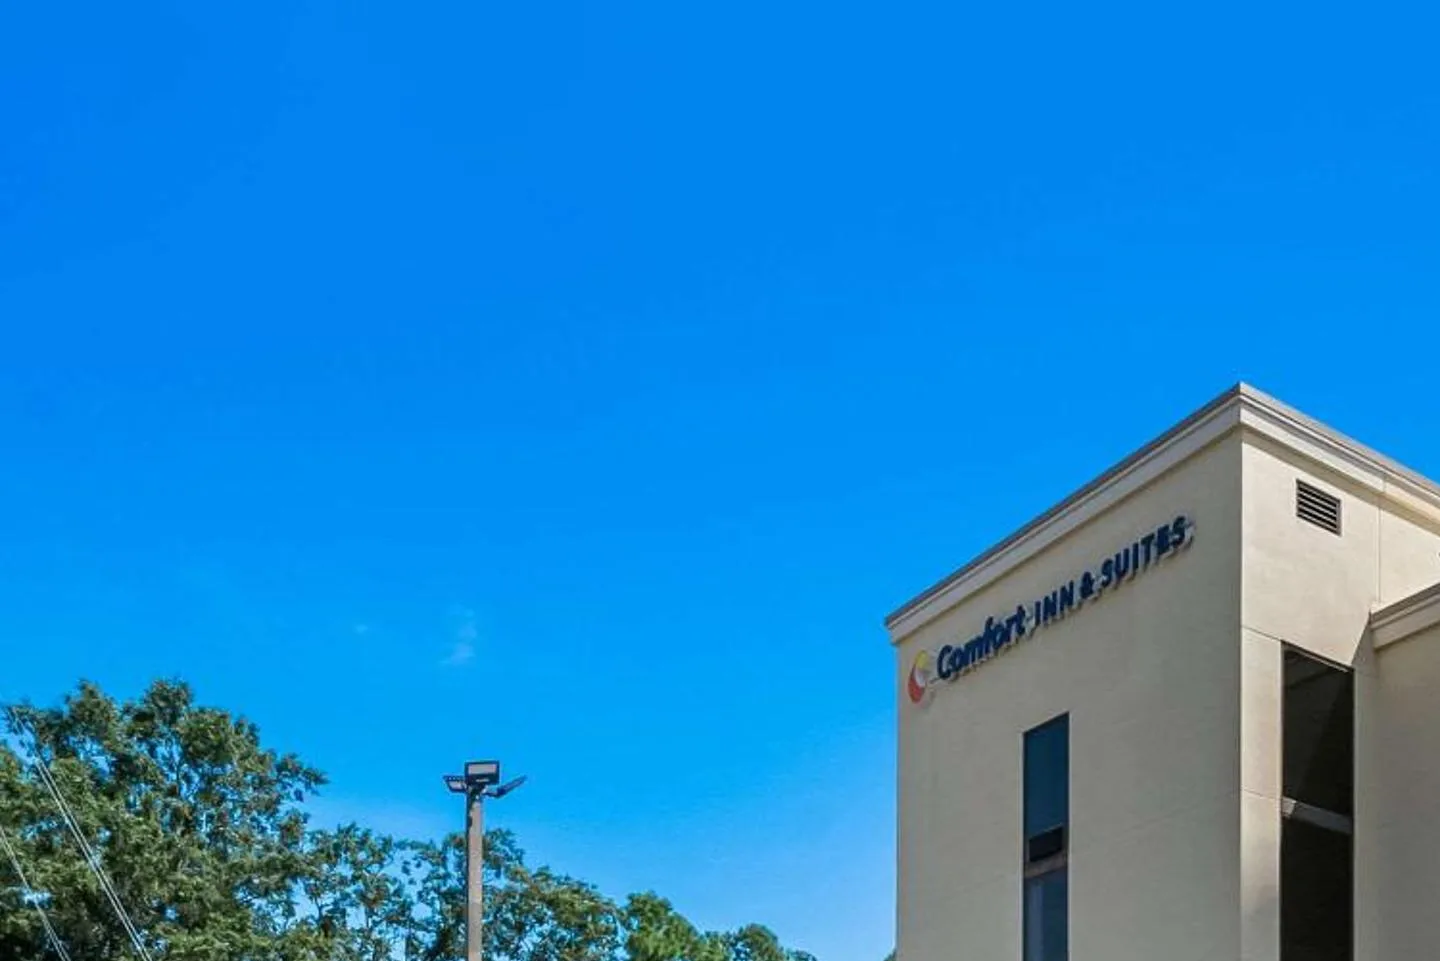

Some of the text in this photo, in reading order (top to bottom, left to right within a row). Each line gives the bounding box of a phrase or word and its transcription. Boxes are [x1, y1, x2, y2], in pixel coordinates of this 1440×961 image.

[937, 605, 1026, 680] Comfort
[1034, 580, 1075, 628] INN
[1080, 571, 1096, 599] &
[1100, 515, 1187, 588] SUITES
